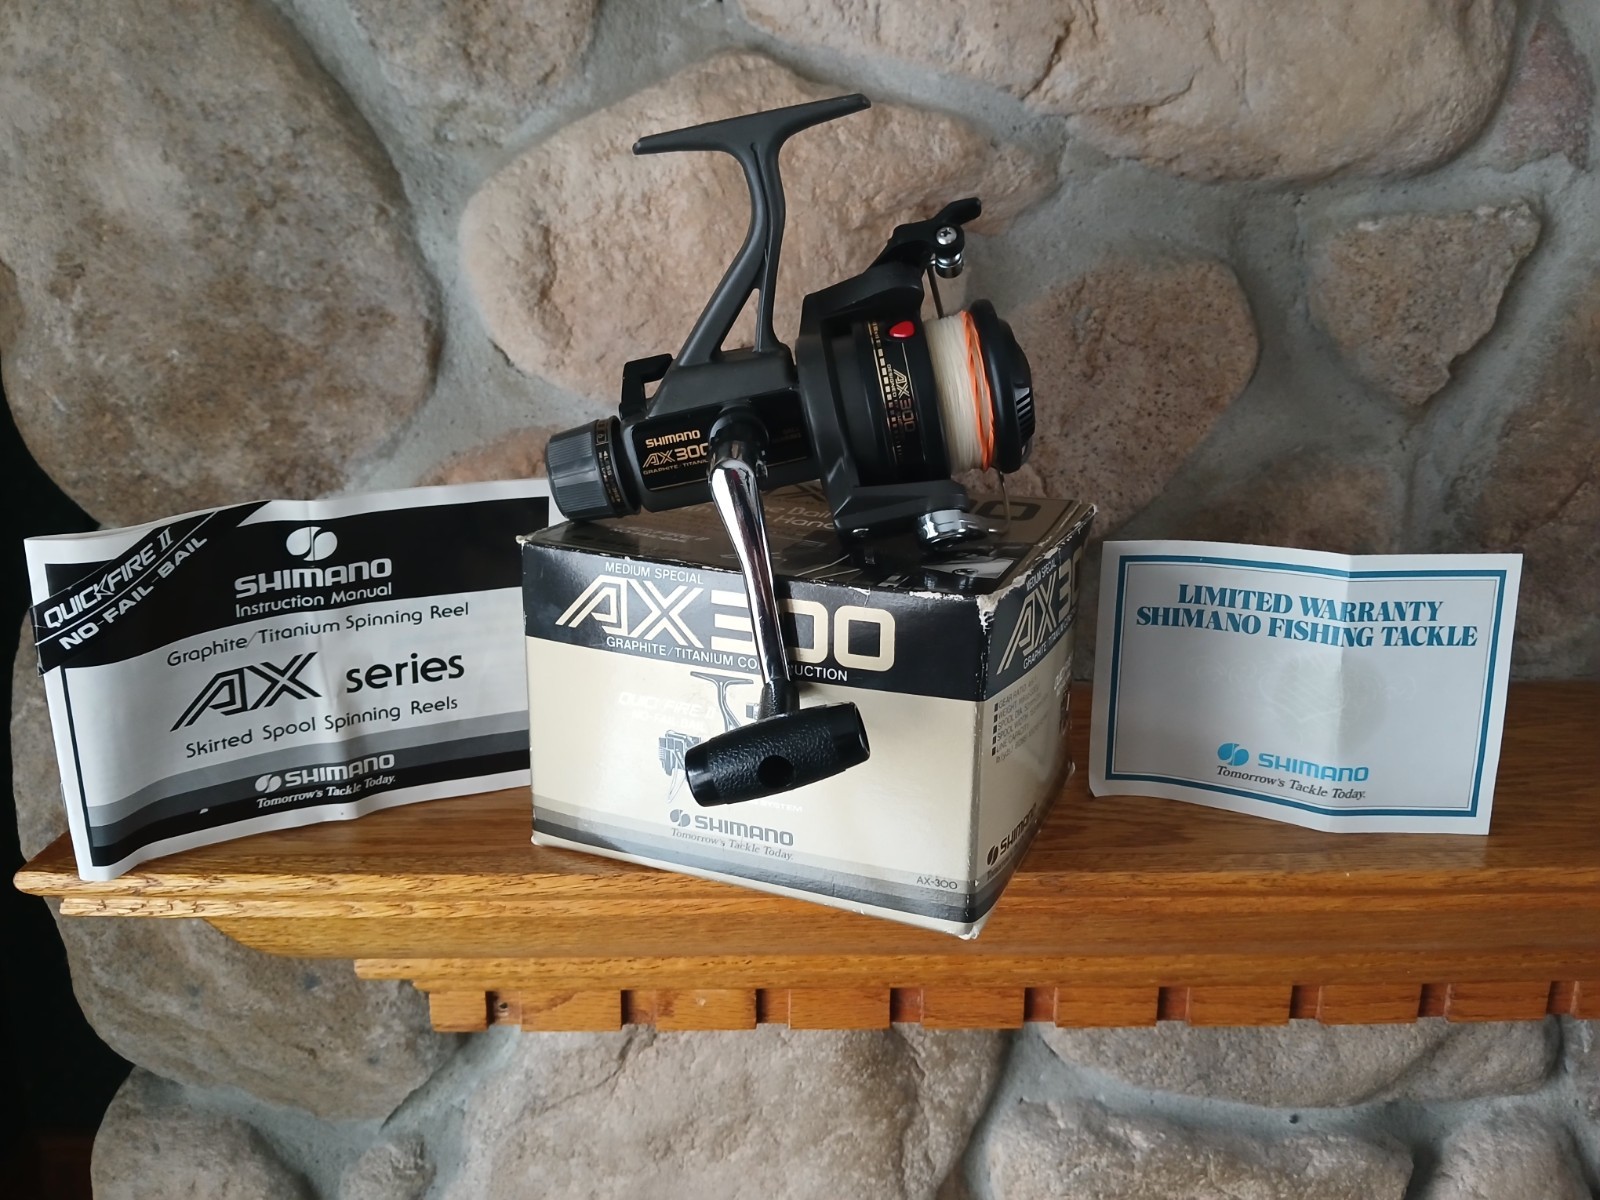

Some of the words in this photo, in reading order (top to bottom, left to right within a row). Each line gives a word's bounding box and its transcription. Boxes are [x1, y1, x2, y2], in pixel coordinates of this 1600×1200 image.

[645, 429, 701, 449] SHIMANO
[43, 542, 157, 629] QUICKFIRE
[158, 526, 174, 552] II
[234, 558, 393, 598] SHIMANO
[605, 561, 650, 577] MEDIUM
[654, 567, 704, 584] SPECIAL
[235, 594, 325, 618] Instruction
[330, 582, 393, 604] Manual
[345, 608, 423, 631] Spinning
[430, 602, 469, 619] Reel
[1178, 583, 1293, 614] LIMITED
[1299, 595, 1443, 623] WARRANTY
[1136, 606, 1261, 635] SHIMANO
[1268, 617, 1375, 647] FISHING
[1381, 626, 1478, 646] TACKLE
[737, 656, 848, 682] COUCTION
[170, 652, 322, 732] AX
[346, 652, 465, 693] series
[186, 729, 253, 758] Skirted
[263, 717, 316, 742] Spool
[324, 704, 401, 731] Spinning
[410, 696, 458, 715] Reels
[284, 754, 395, 788] SHIMANO
[1216, 765, 1286, 789] Tomorrow's
[1289, 779, 1328, 798] Tackle
[1258, 753, 1369, 782] SHIMANO
[256, 787, 324, 809] Tomorrow's
[326, 780, 362, 798] Tackle
[671, 828, 726, 846] Tomorrow's
[729, 839, 760, 854] Tackle
[695, 814, 793, 847] SHIMANO
[916, 875, 958, 890] AX-300
